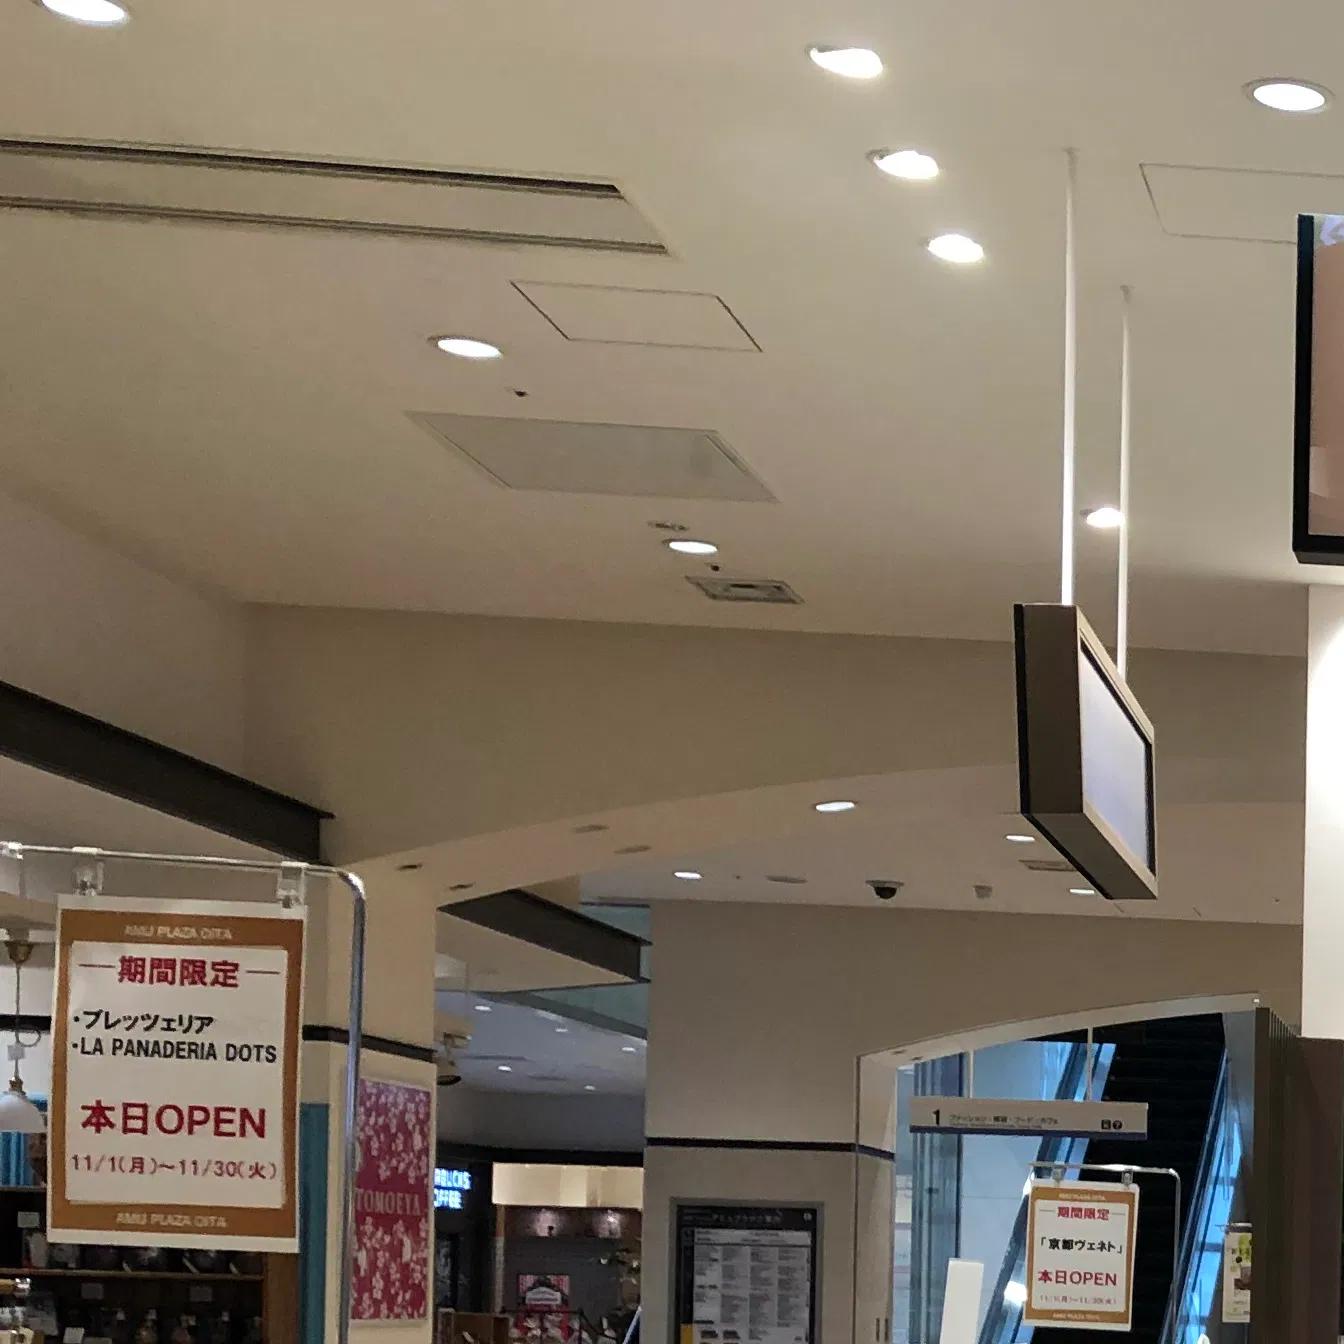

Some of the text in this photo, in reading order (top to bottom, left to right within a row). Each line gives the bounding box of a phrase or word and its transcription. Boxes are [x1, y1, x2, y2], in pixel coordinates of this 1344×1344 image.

[117, 955, 241, 989] 期間限定
[112, 1039, 217, 1063] PANADERIA
[226, 1043, 278, 1065] DOTS
[80, 1099, 268, 1139] 本日OPEN
[932, 1109, 941, 1126] 1
[1057, 1206, 1110, 1221] 期間限定
[1038, 1269, 1118, 1287] 本日OPEN
